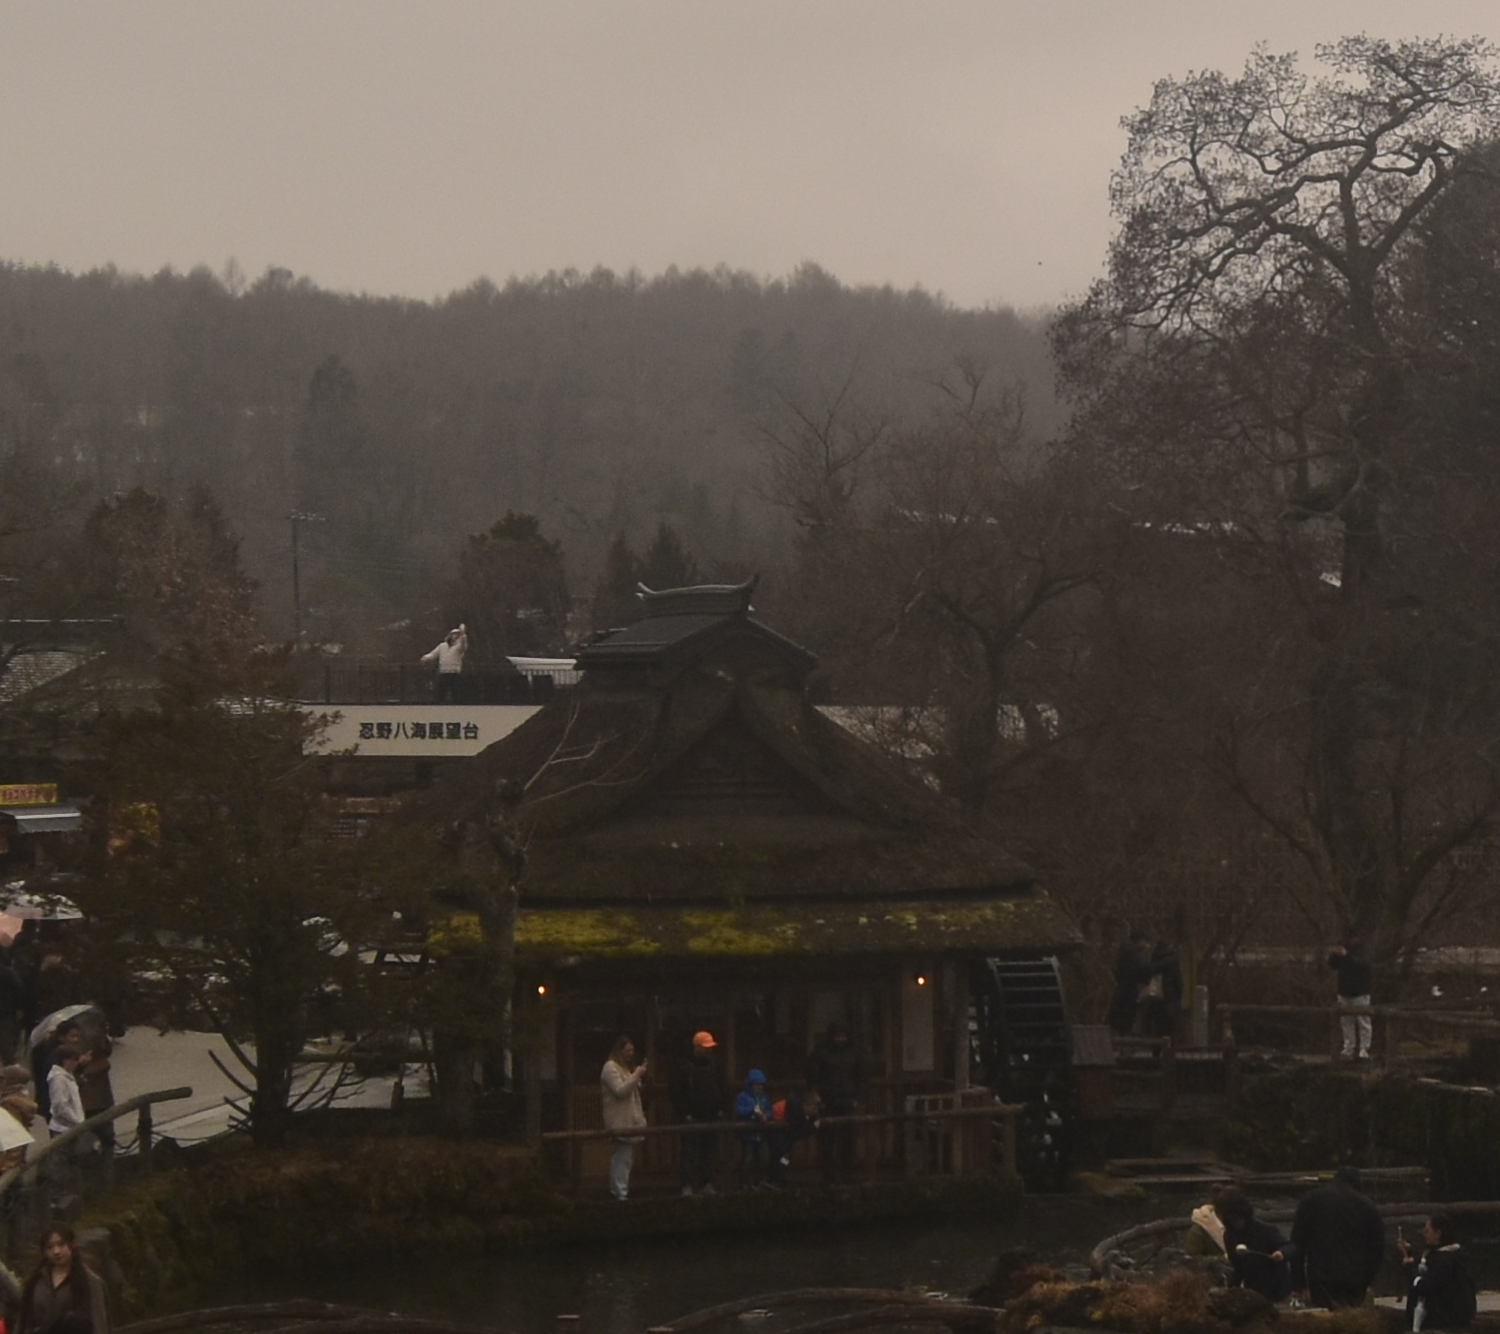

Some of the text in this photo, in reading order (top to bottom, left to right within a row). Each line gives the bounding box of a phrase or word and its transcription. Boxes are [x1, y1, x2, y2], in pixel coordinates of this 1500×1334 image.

[359, 721, 479, 740] 忍野八海展望台
